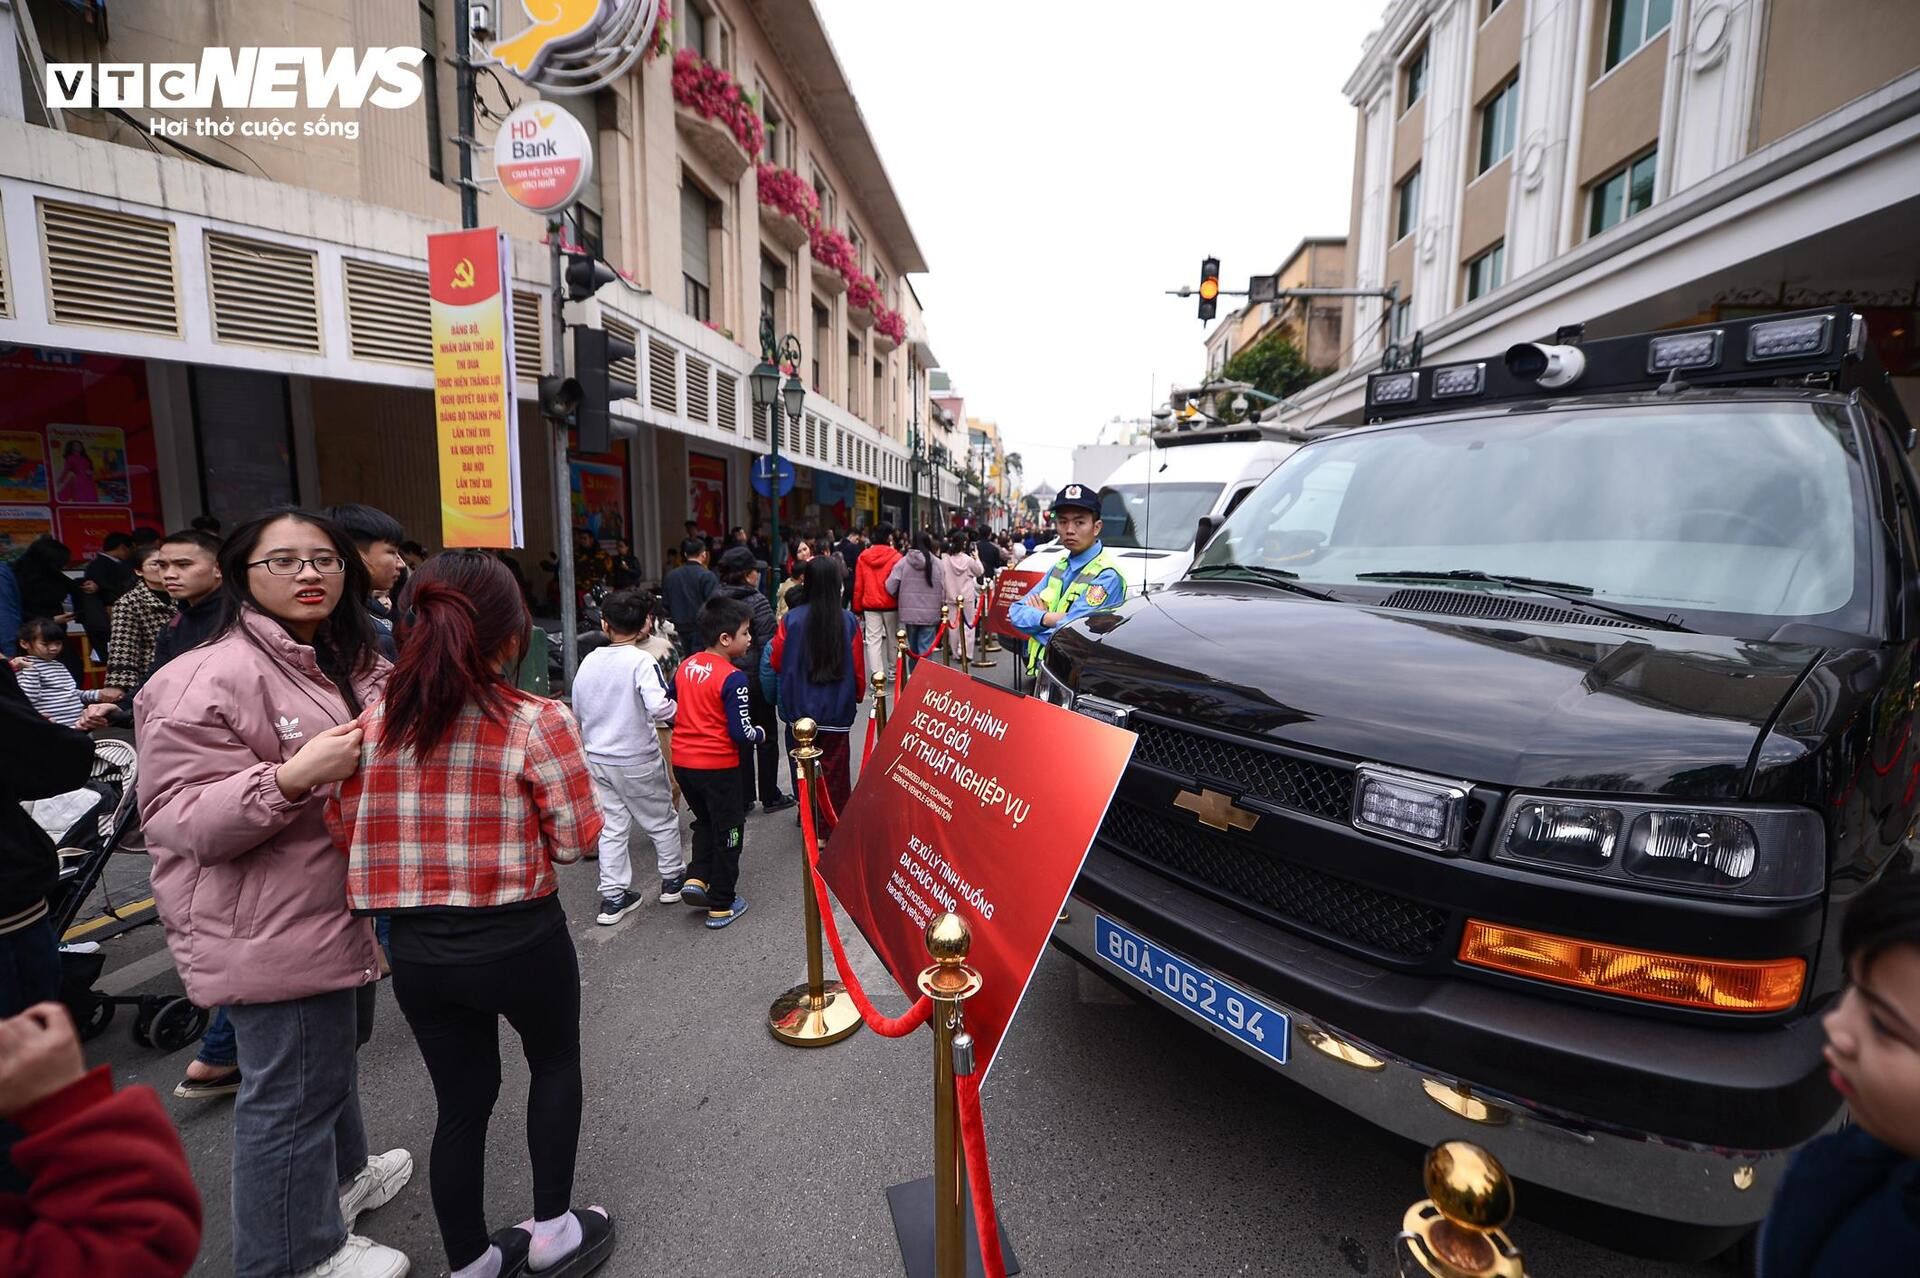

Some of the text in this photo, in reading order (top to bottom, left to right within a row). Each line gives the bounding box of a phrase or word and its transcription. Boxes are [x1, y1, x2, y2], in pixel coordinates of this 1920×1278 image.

[511, 120, 538, 139] HD
[512, 138, 557, 159] Bank
[911, 710, 972, 758] XE CƠ GIỚI,
[922, 689, 1009, 741] KHỐI ĐỘI HÌNH
[892, 772, 953, 822] SERVICE VEHICLE FORMATION
[896, 763, 954, 809] MOTORIZED AND TECHNICAL
[900, 732, 1031, 829] KỸ THUẬT NGHIỆP VỤ
[891, 870, 934, 918] Multi-functional
[899, 852, 957, 914] ĐA CHỨC NĂNG
[907, 834, 921, 852] XE
[917, 844, 933, 861] XỬ
[928, 854, 942, 869] LÝ
[938, 861, 961, 888] TÌNH
[958, 880, 995, 921] HUỐNG
[886, 880, 926, 930] handling vehicle
[1108, 931, 1265, 1042] 80A-062.94
